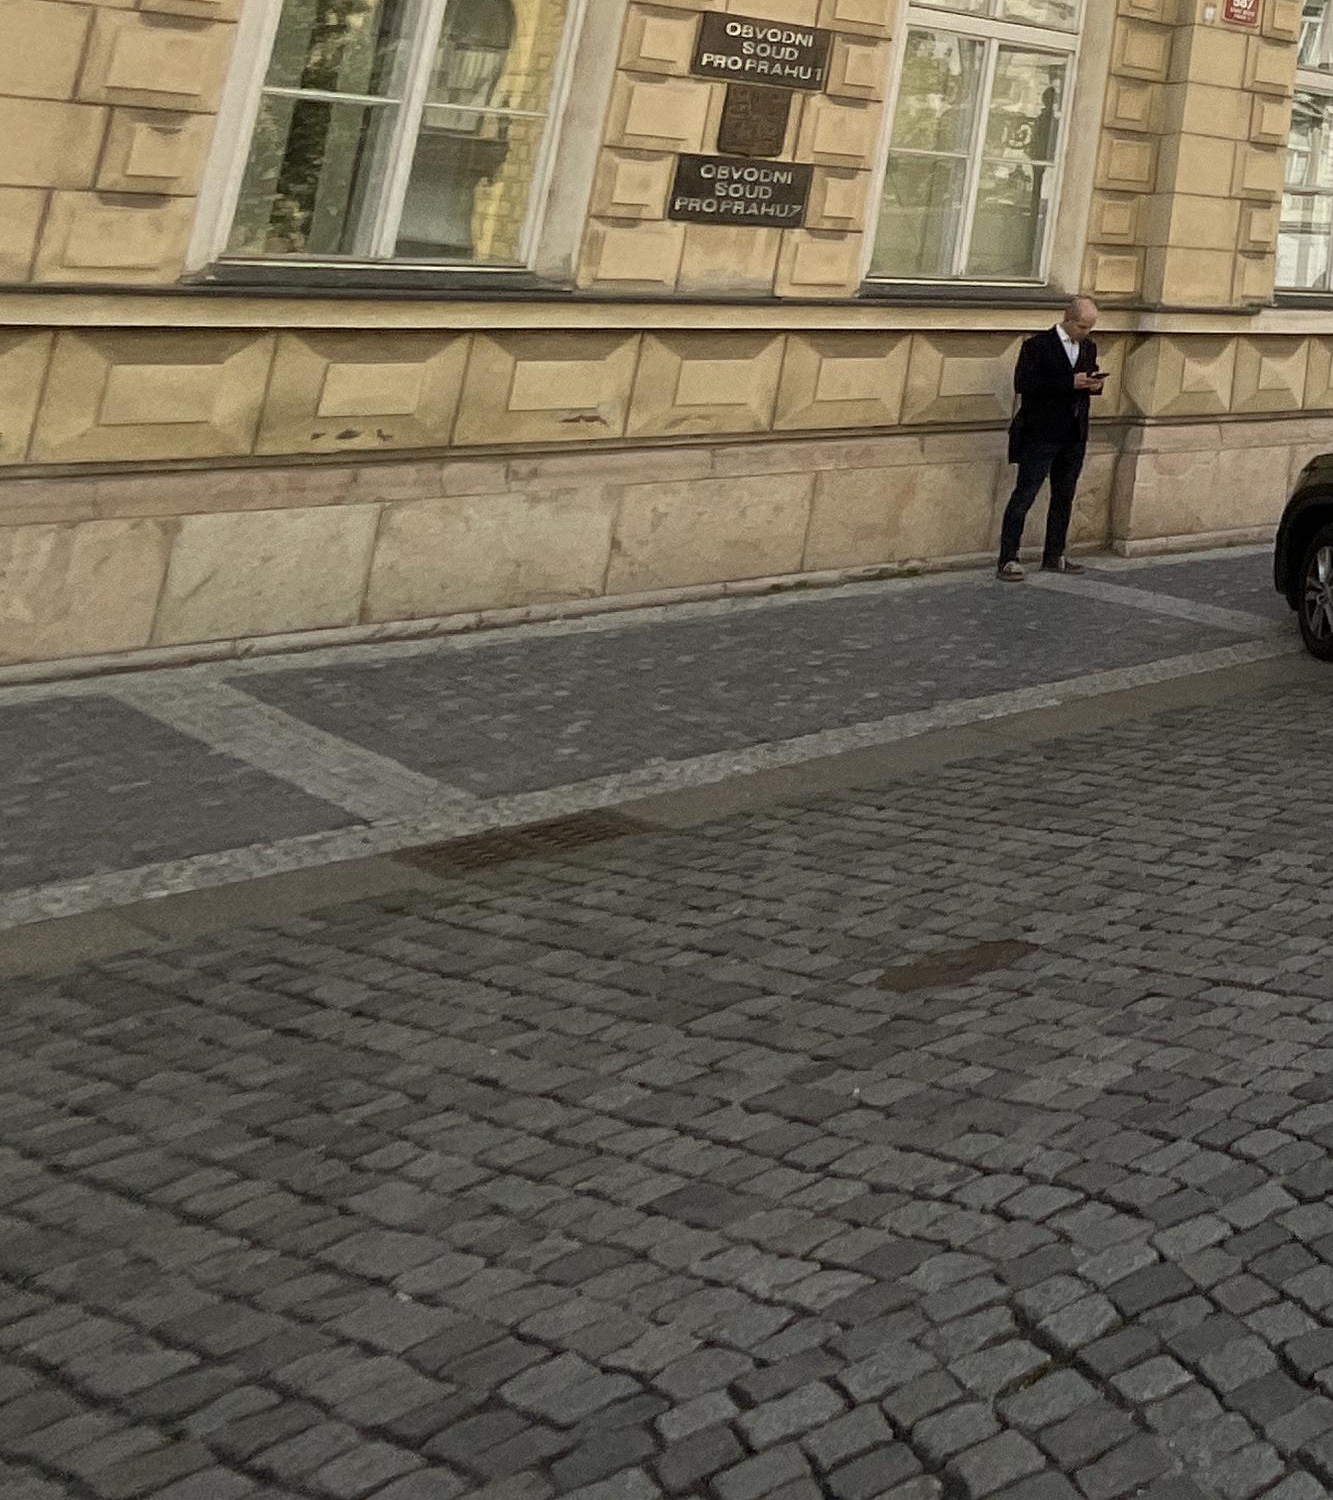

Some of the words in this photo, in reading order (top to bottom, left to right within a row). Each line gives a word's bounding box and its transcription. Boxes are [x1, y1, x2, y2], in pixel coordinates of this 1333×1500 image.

[742, 41, 799, 61] SOUD
[701, 52, 743, 70] PRO
[744, 58, 812, 80] PRAHU
[815, 68, 823, 81] 1
[715, 181, 772, 199] SOUD
[674, 197, 717, 213] PRO
[719, 200, 788, 217] PRAHU
[788, 205, 802, 218] 7
